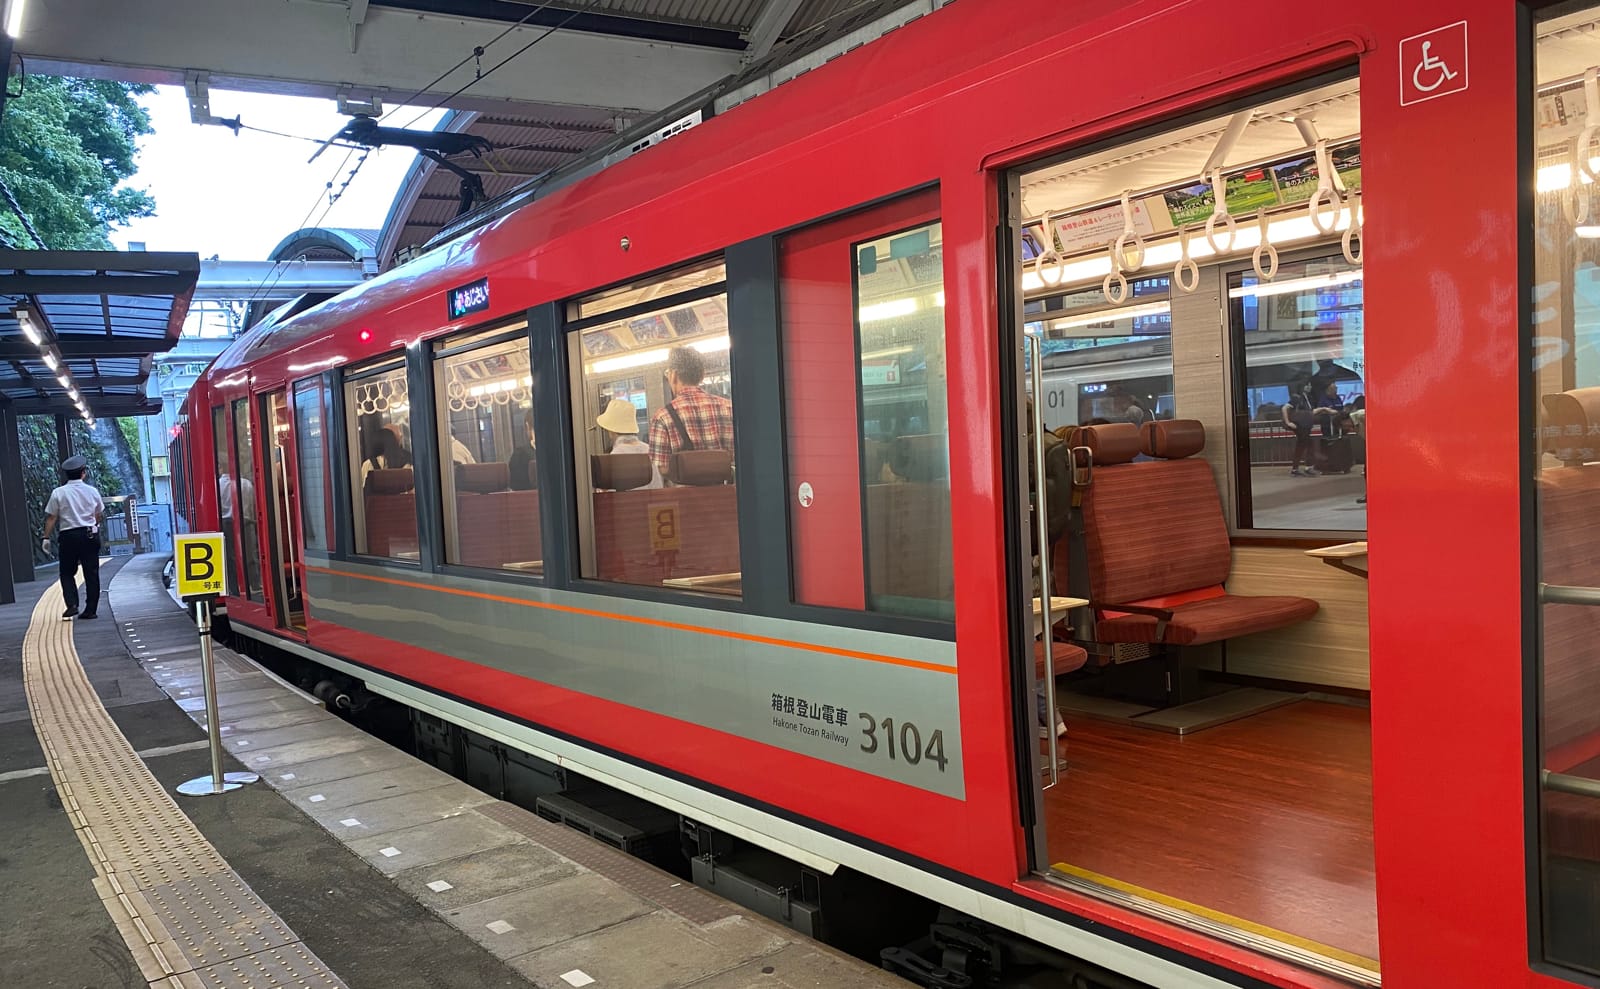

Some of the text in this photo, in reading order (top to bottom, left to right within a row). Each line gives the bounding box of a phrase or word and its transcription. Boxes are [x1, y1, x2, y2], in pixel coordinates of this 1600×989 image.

[184, 543, 214, 581] B
[203, 581, 221, 590] 号車
[771, 693, 848, 727] 箱根登山電車
[772, 717, 849, 747] Hakone Tozan Railway
[858, 712, 948, 773] 3104
